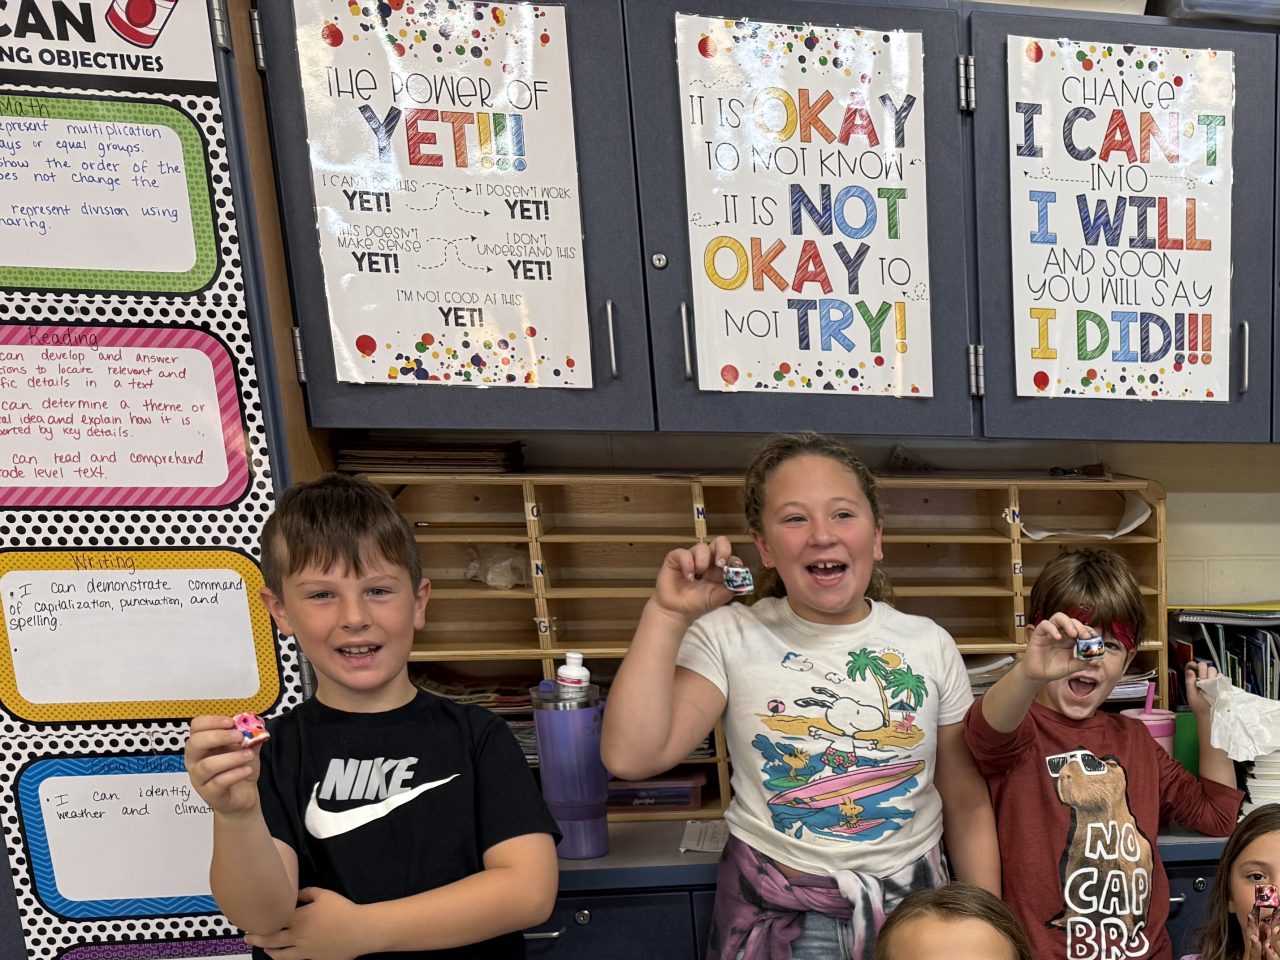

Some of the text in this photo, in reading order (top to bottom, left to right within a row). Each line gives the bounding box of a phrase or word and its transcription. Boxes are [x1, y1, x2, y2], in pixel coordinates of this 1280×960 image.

[38, 49, 164, 72] OBJECTIVES
[505, 79, 548, 110] OF
[0, 96, 51, 118] Math
[689, 86, 917, 148] IT IS OKAY
[67, 123, 161, 140] multiplication
[358, 104, 527, 172] YET!!!
[1015, 101, 1226, 167] I CAN'T
[56, 140, 144, 157] equal groups.
[45, 158, 181, 175] the order of the
[705, 141, 905, 181] TO NOT KNOW
[33, 172, 160, 191] not change the
[1090, 163, 1148, 193] INTO
[342, 189, 392, 213] YET!
[541, 186, 572, 199] WORK
[11, 203, 178, 222] represent division using
[504, 198, 550, 221] YET!
[723, 183, 909, 240] IT IS NOT
[1028, 190, 1212, 251] I WILL
[513, 233, 547, 245] DON'T
[352, 251, 400, 274] YET!
[556, 246, 576, 259] THIS
[1043, 247, 1180, 278] AND SOON
[507, 259, 552, 281] YET!
[704, 235, 911, 294] OKAY TO
[415, 291, 522, 307] NOT GOOD THIS
[1101, 279, 1141, 305] WILL
[438, 306, 484, 328] YET!
[725, 298, 909, 354] NOT TRY!
[28, 327, 99, 351] Reading
[1029, 307, 1213, 365] I DID!!!
[41, 349, 179, 364] develop and answer
[59, 364, 187, 379] locate relevant and
[28, 377, 154, 389] details text
[2, 397, 206, 412] can determine theme or
[20, 411, 152, 429] idea and explain how
[39, 425, 133, 441] by key details.
[12, 450, 204, 467] can read and comprehend
[34, 465, 107, 479] level text.
[68, 553, 136, 575] Writing
[51, 577, 243, 594] can demonstrate command
[10, 593, 219, 617] of capitalization, punctuation, and
[10, 615, 62, 631] spelling.
[319, 757, 419, 800] NIKE
[93, 785, 191, 802] can identify
[57, 804, 150, 821] weather and
[1085, 821, 1140, 862] NO
[1065, 868, 1149, 916] CAP
